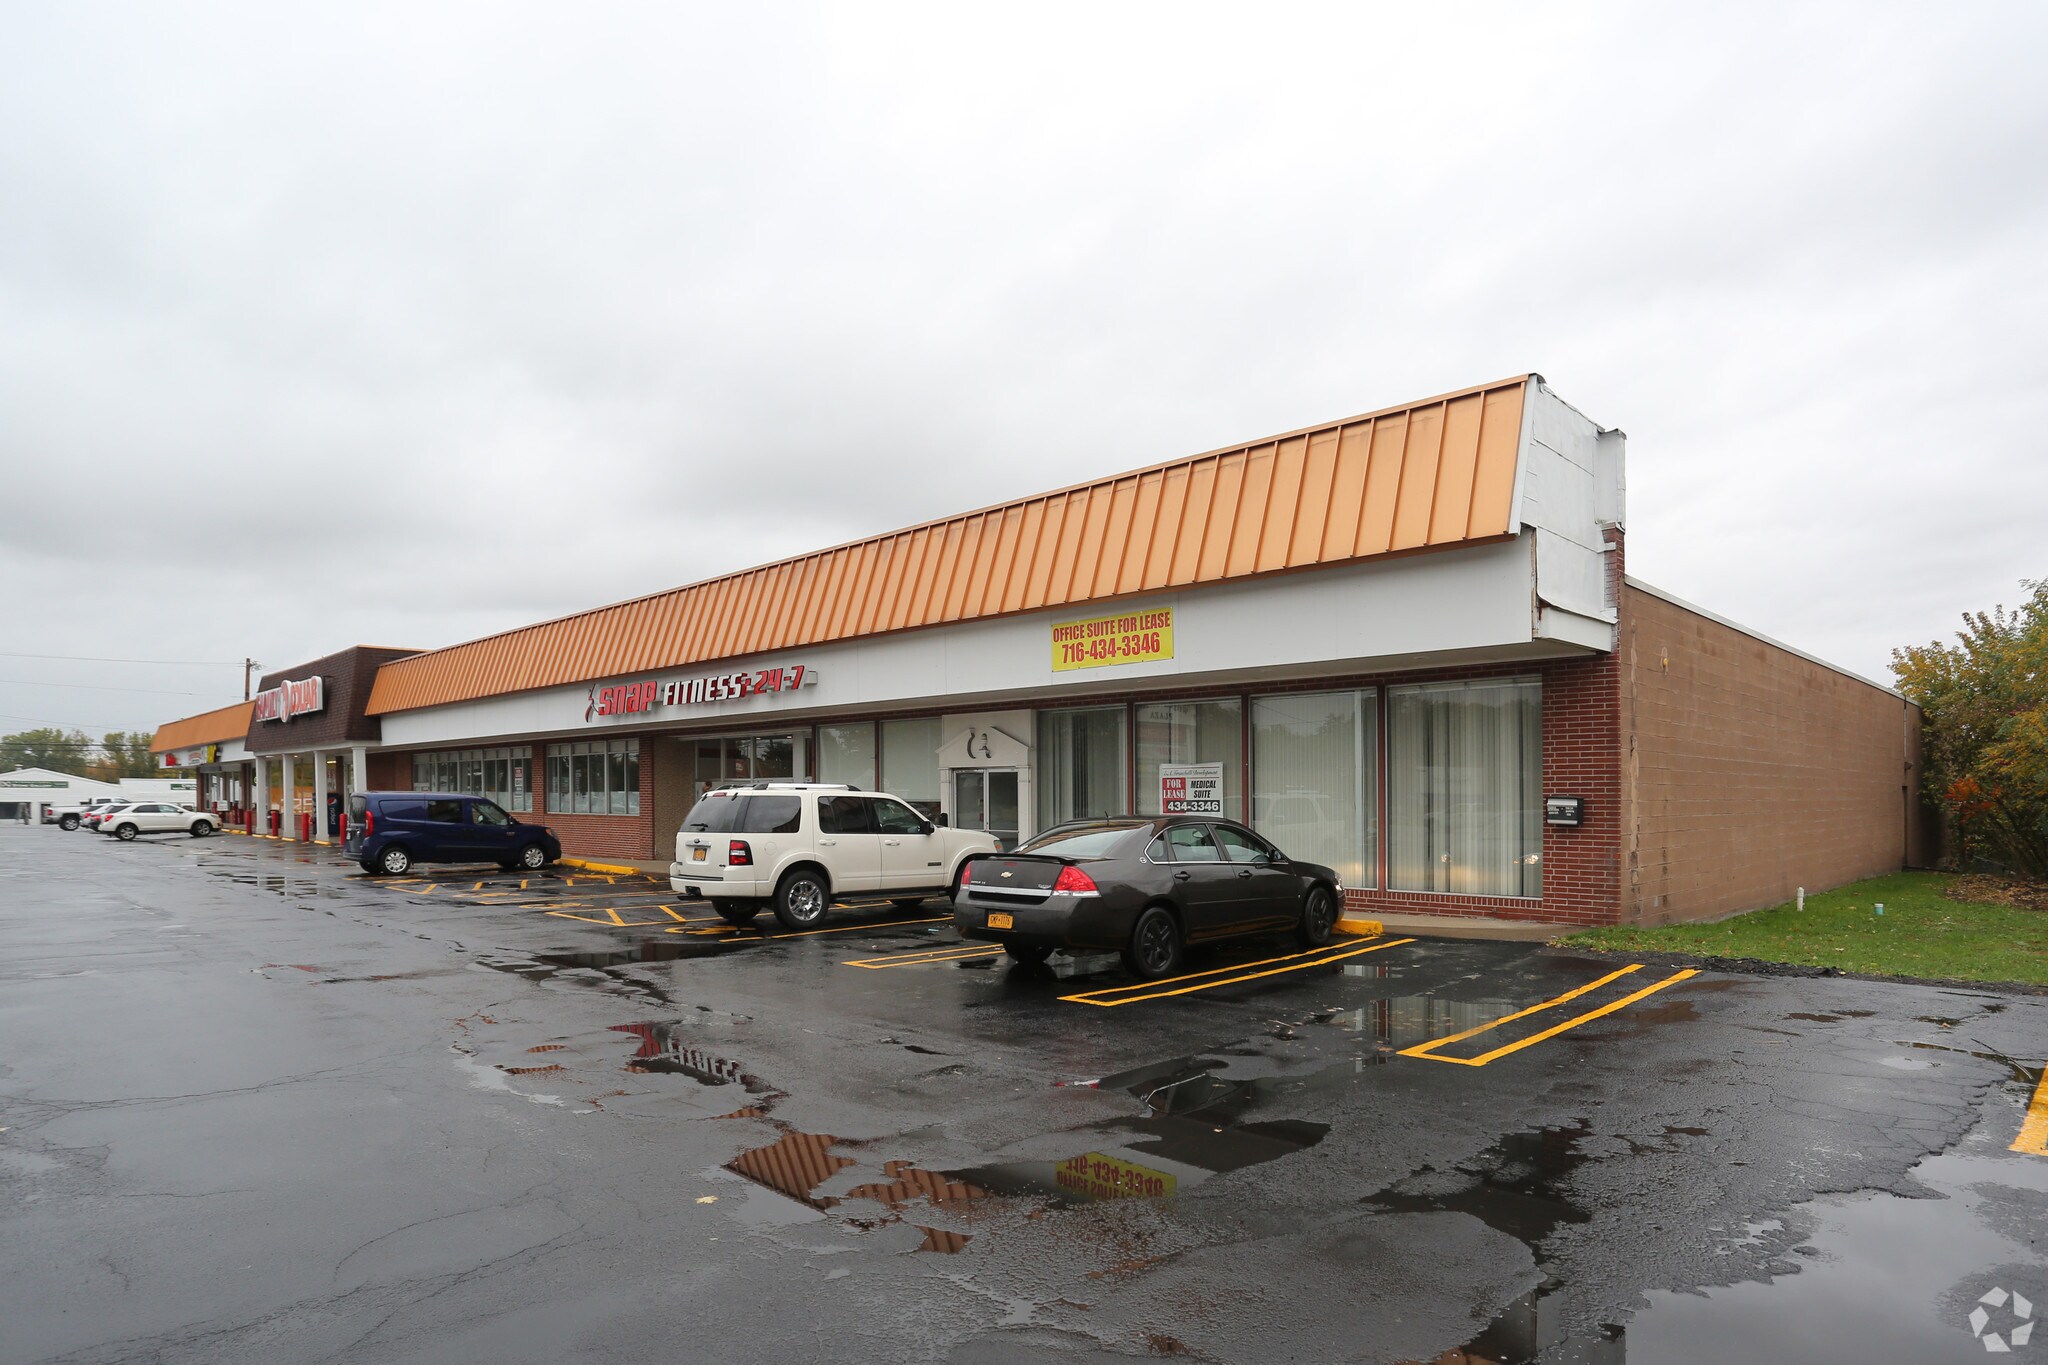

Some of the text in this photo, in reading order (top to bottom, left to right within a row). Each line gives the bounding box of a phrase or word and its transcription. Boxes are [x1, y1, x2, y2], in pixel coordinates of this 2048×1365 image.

[1053, 612, 1171, 643] OFFICE SUITE FOR LEASE
[1062, 632, 1160, 663] 716-434-3346
[753, 665, 805, 695] 24-7
[1166, 779, 1181, 788] FOR
[1190, 780, 1216, 788] MEDICAL
[1163, 789, 1185, 798] LEASE
[1193, 790, 1211, 798] SUITE
[1168, 801, 1219, 811] 434-3346
